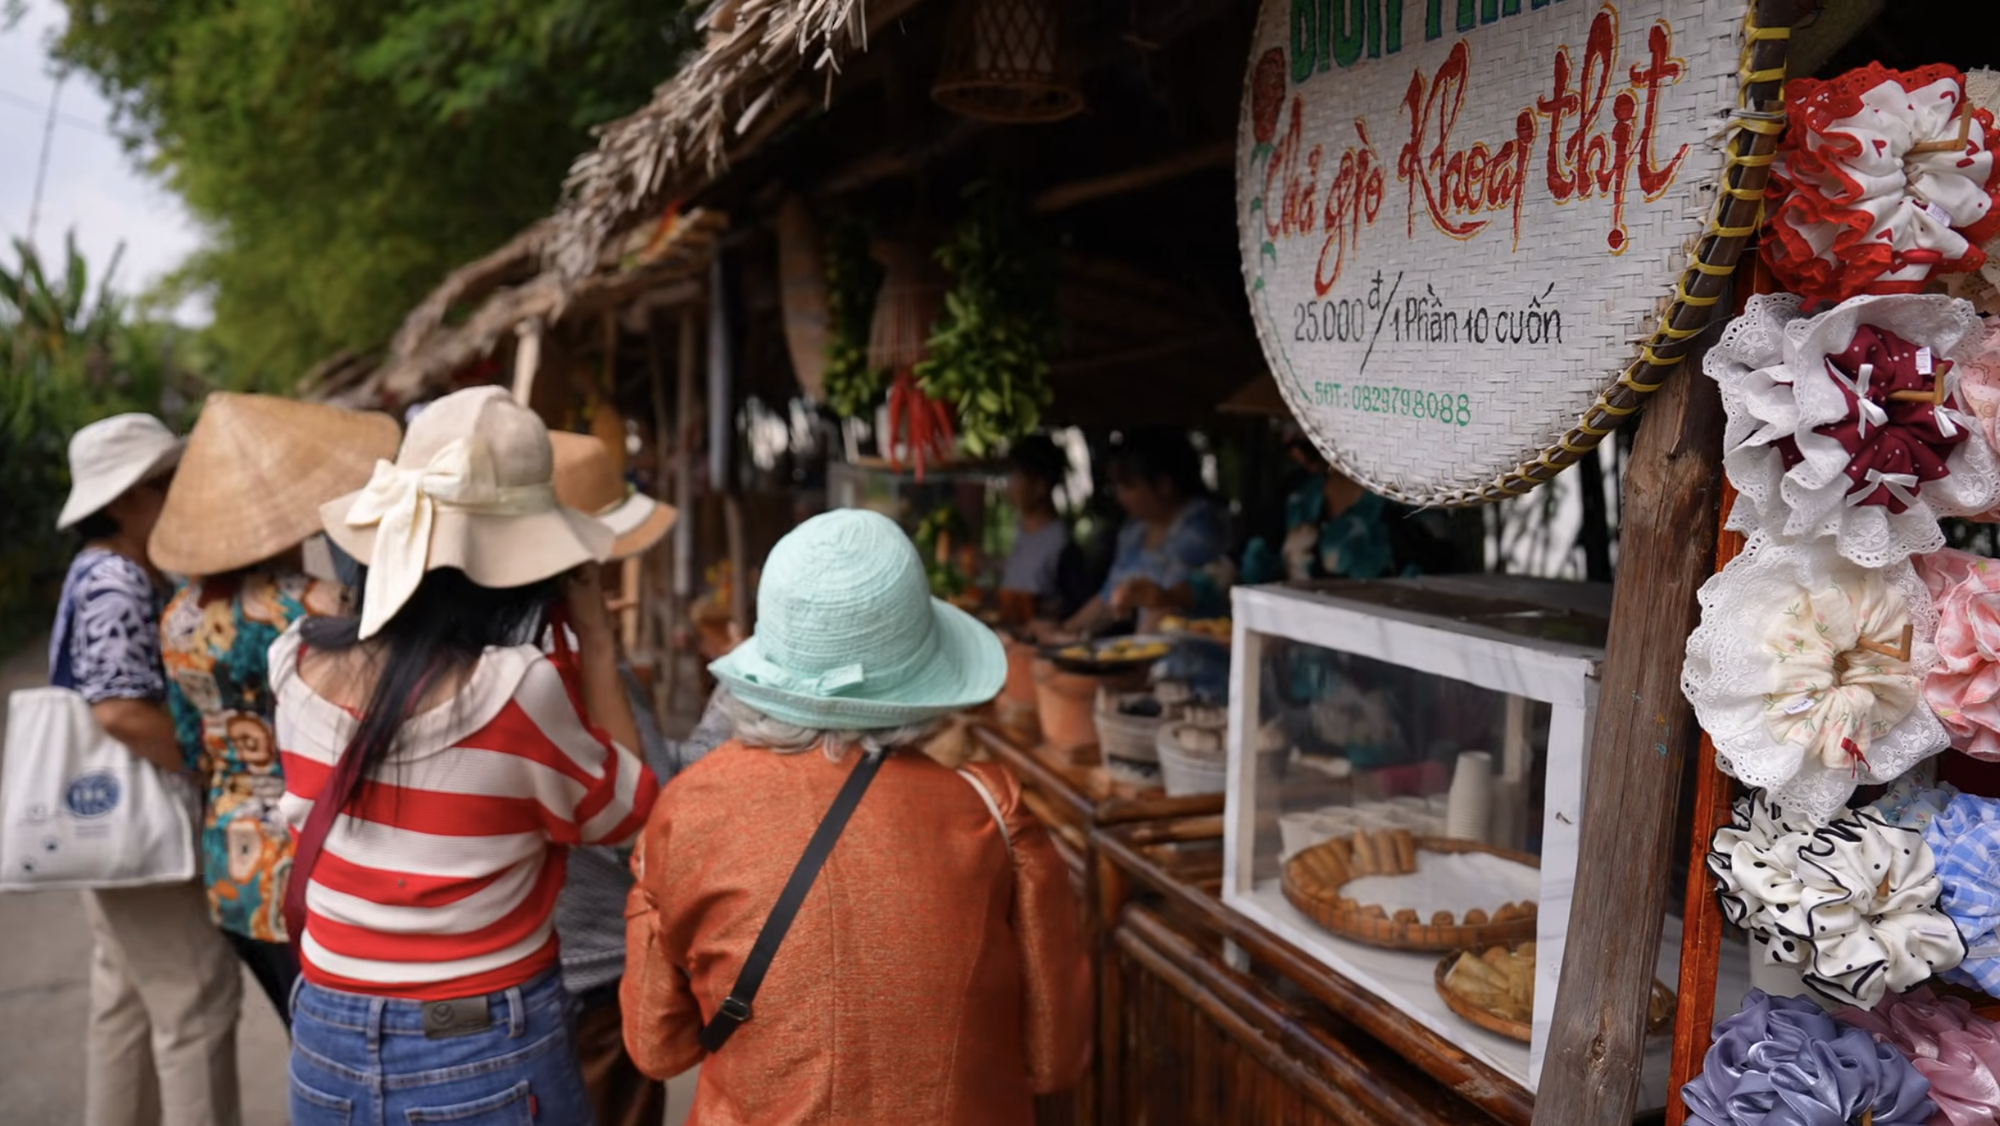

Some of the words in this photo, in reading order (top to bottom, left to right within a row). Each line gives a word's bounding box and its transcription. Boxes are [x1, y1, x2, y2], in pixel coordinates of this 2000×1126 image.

[1536, 2, 1691, 256] thịt
[1462, 307, 1489, 344] 10
[1494, 281, 1563, 345] cuốn
[1351, 385, 1471, 426] 0829798088
